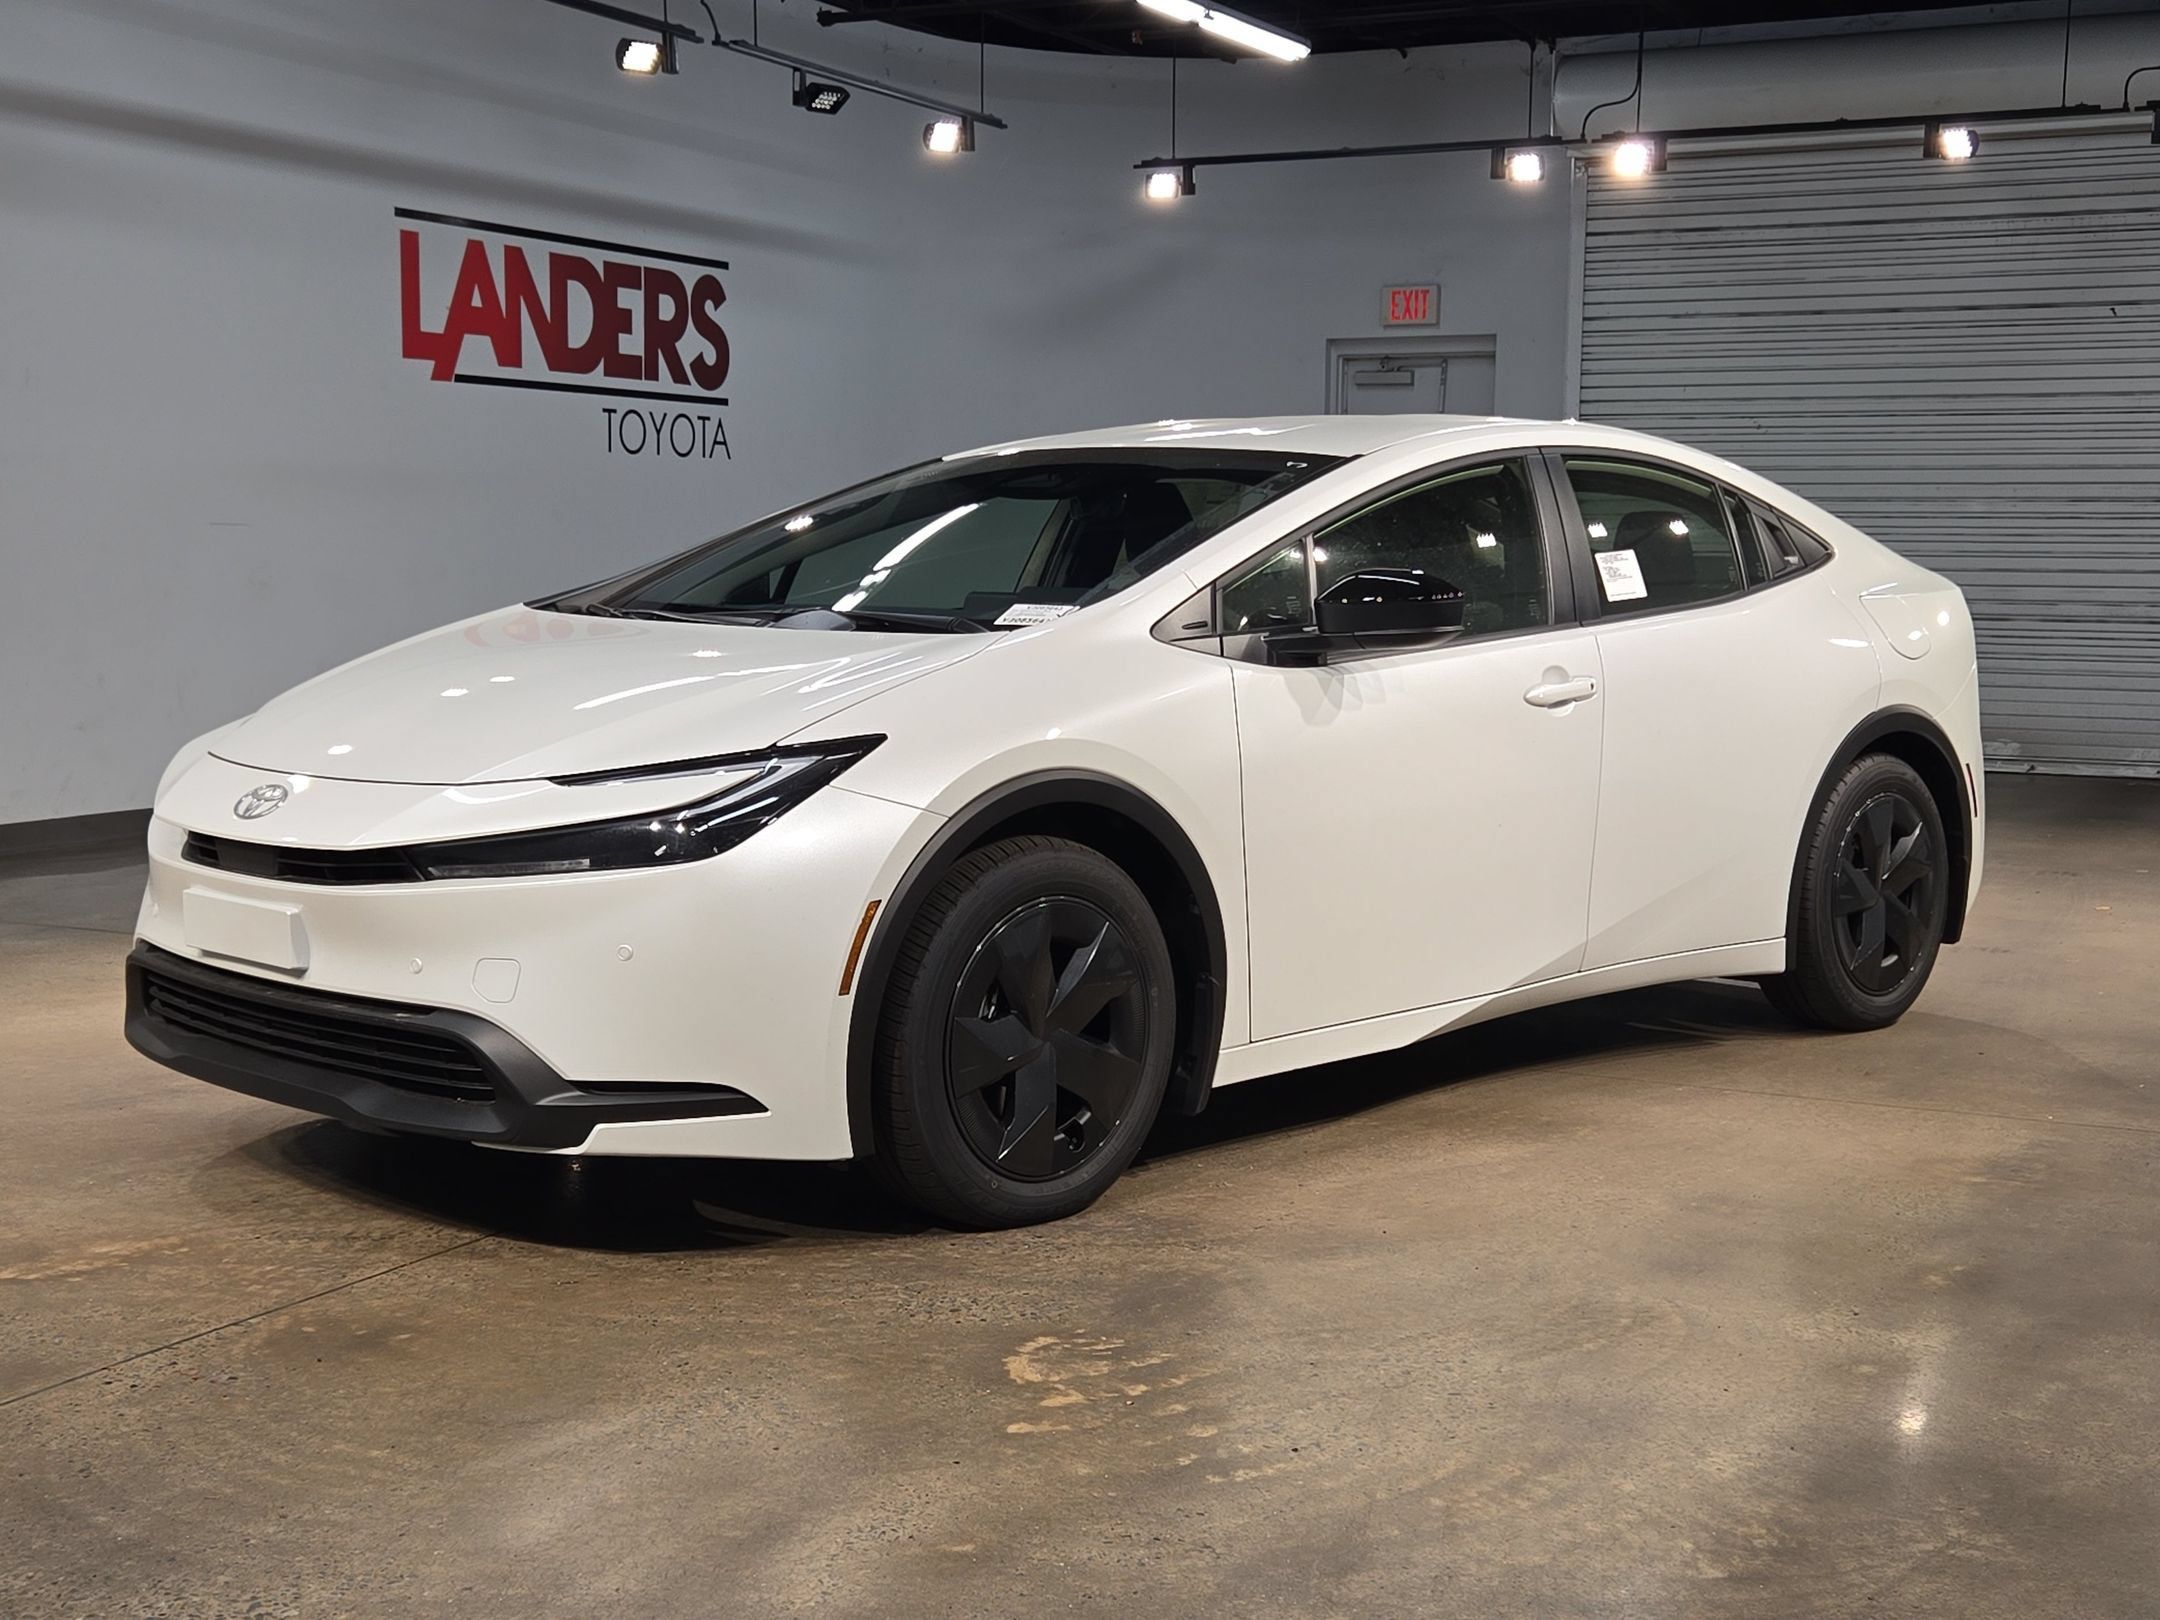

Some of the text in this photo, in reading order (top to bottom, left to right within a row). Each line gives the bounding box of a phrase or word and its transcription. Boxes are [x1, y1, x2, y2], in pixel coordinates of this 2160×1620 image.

[400, 229, 730, 391] LANDERS
[1391, 289, 1430, 321] EXIT
[602, 408, 731, 460] TOYOTA
